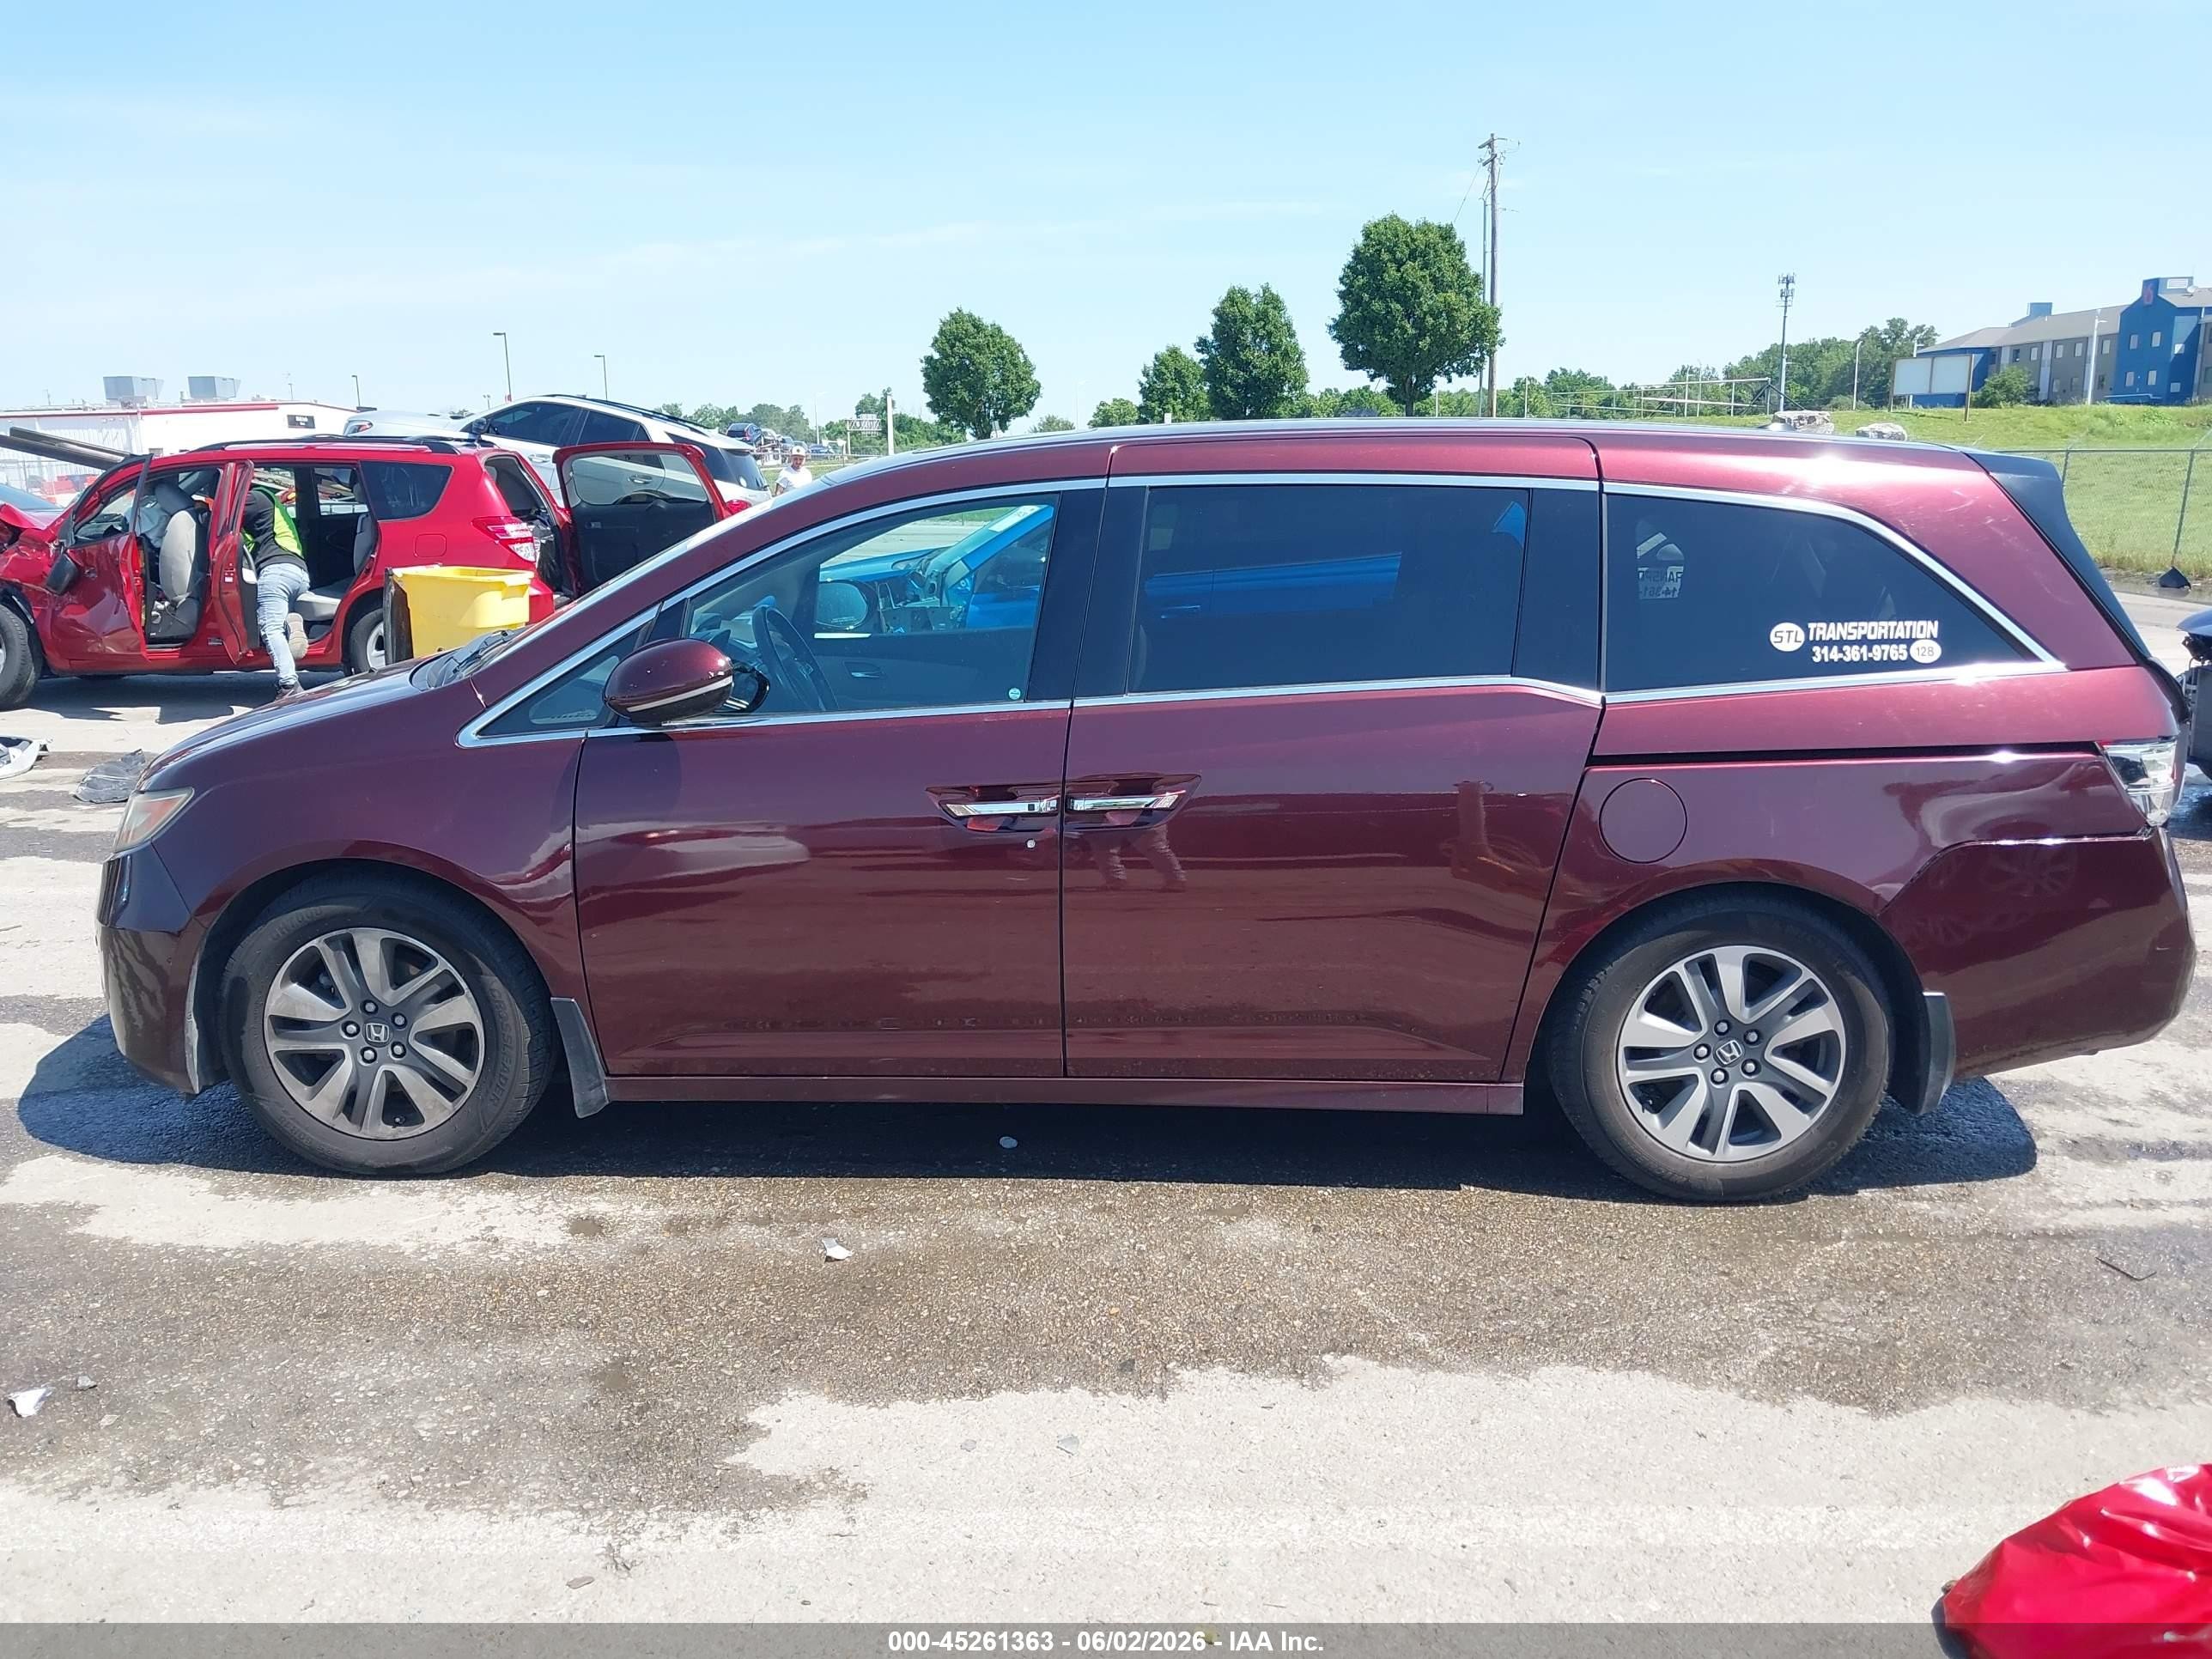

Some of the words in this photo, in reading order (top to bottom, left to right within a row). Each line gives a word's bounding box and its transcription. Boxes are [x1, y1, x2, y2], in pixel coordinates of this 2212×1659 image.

[1773, 630, 1802, 643] STL
[1808, 620, 1939, 641] TRANSPORTATION
[1812, 644, 1908, 663] 314-361-9765
[1916, 646, 1935, 657] 128
